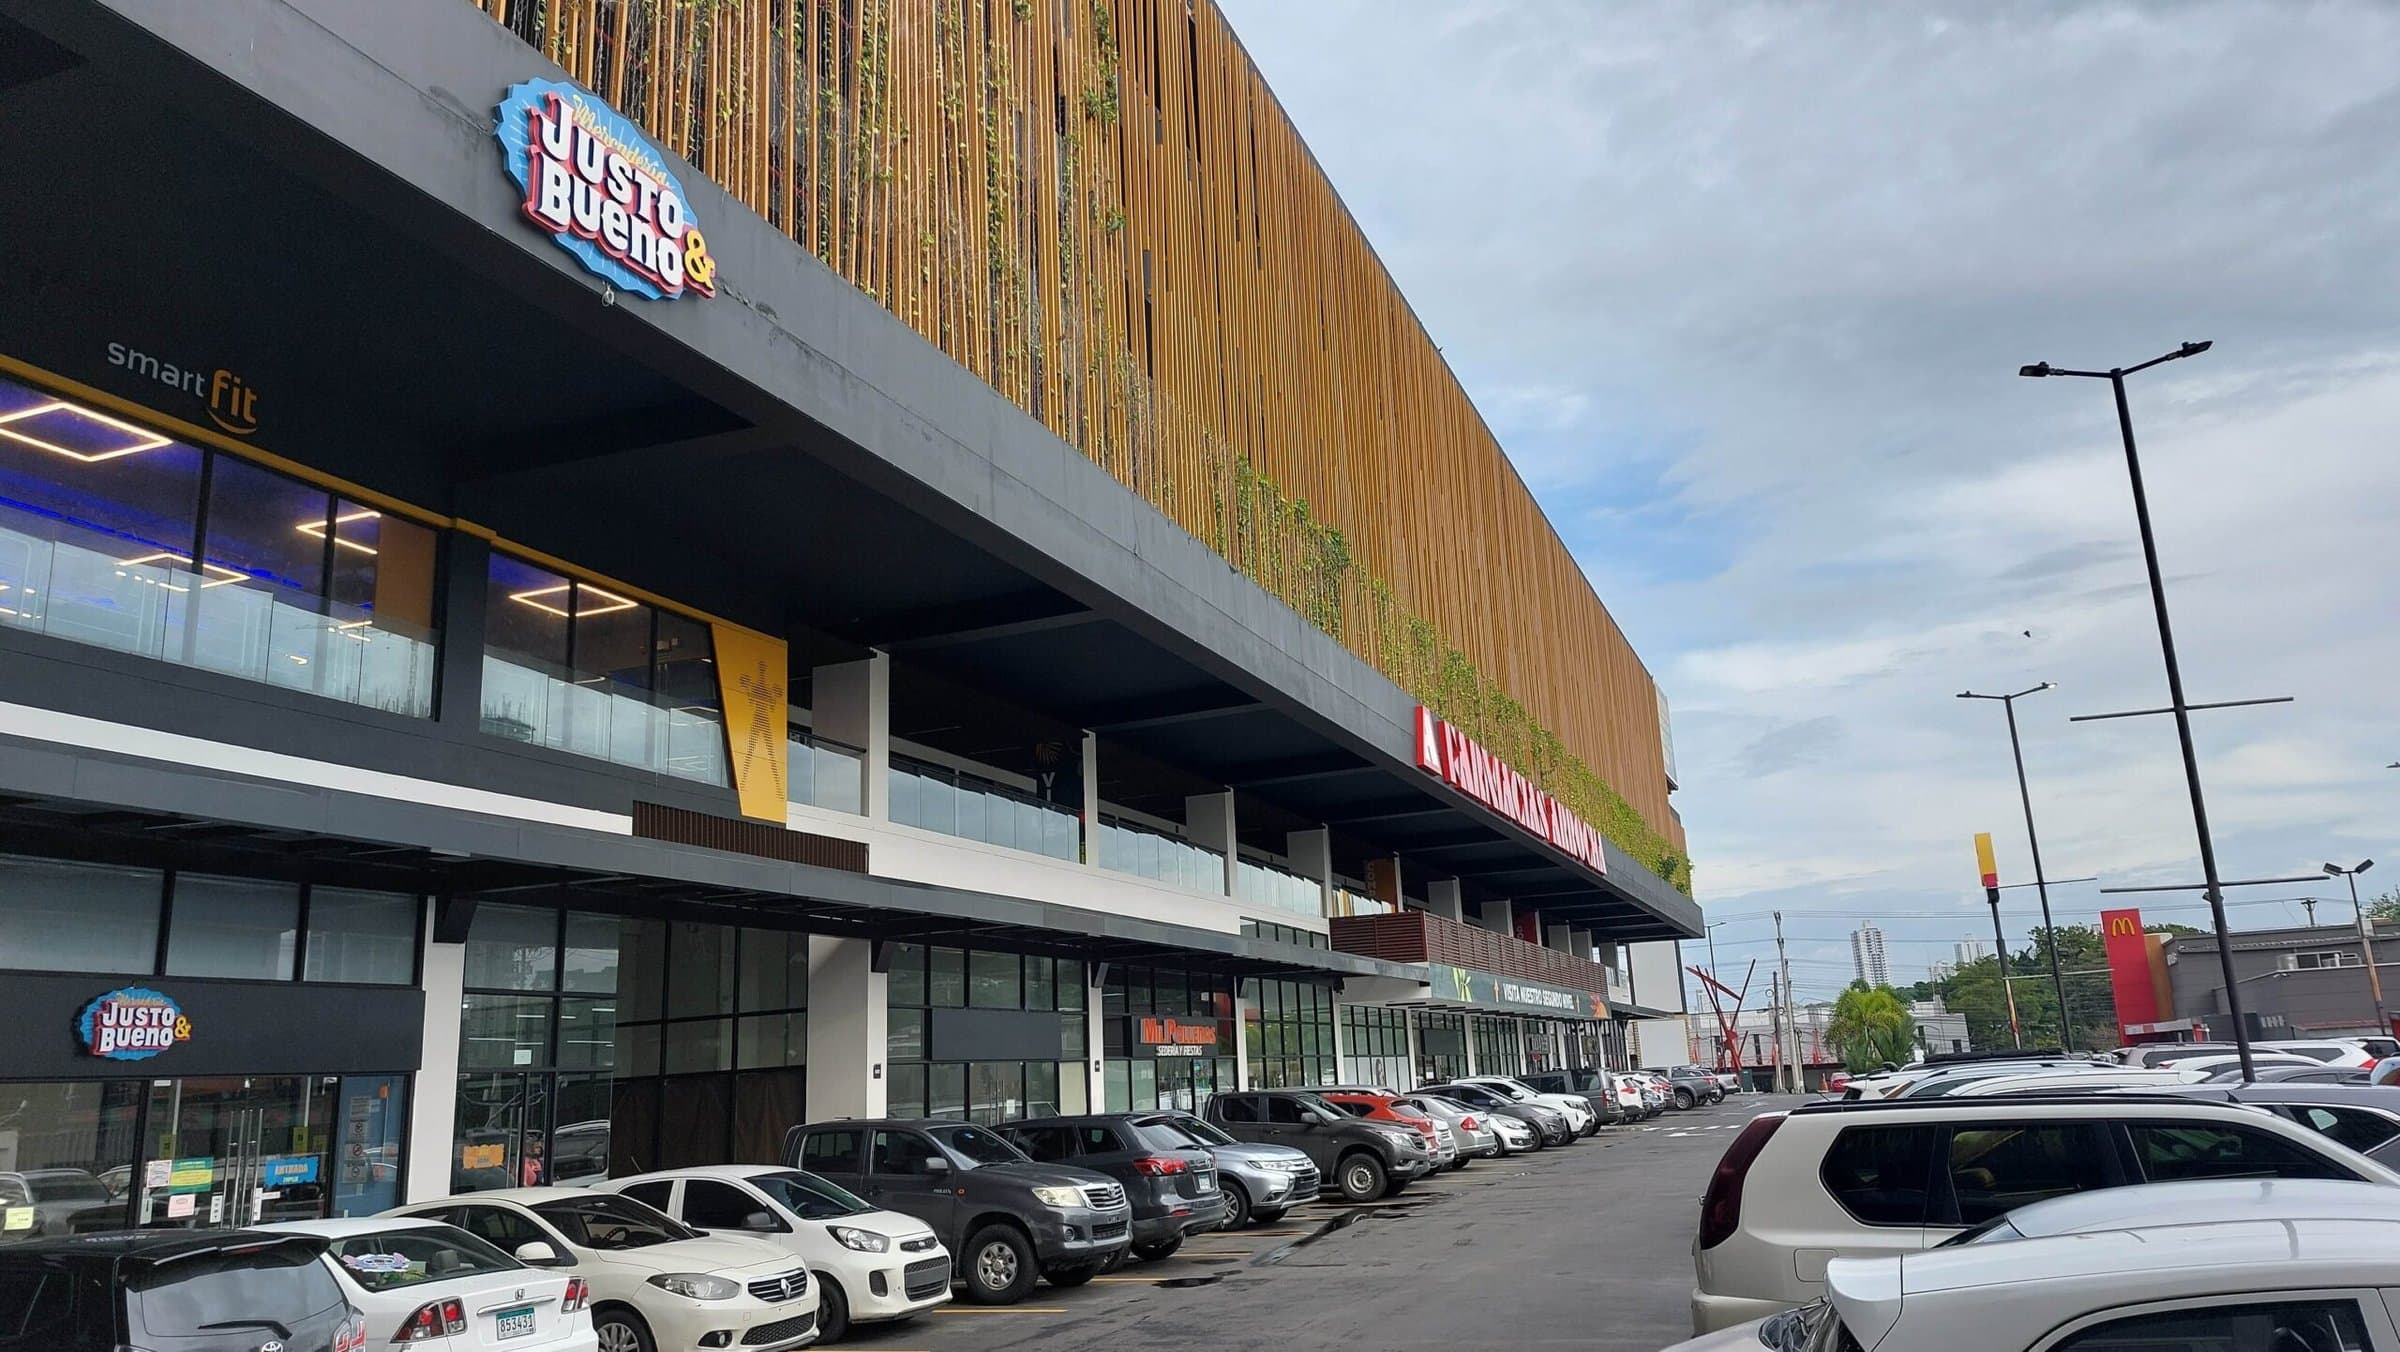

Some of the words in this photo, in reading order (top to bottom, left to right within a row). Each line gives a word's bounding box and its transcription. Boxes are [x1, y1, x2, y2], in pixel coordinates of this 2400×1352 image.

[684, 230, 716, 290] &
[107, 342, 207, 398] smart
[211, 369, 258, 425] fit
[1502, 983, 1520, 1003] VISITA
[1520, 986, 1543, 1005] NUESTRO
[1542, 989, 1563, 1009] SEGUNDO
[102, 1002, 176, 1026] JUSTO
[174, 1015, 192, 1038] &
[500, 1314, 533, 1333] 853431
